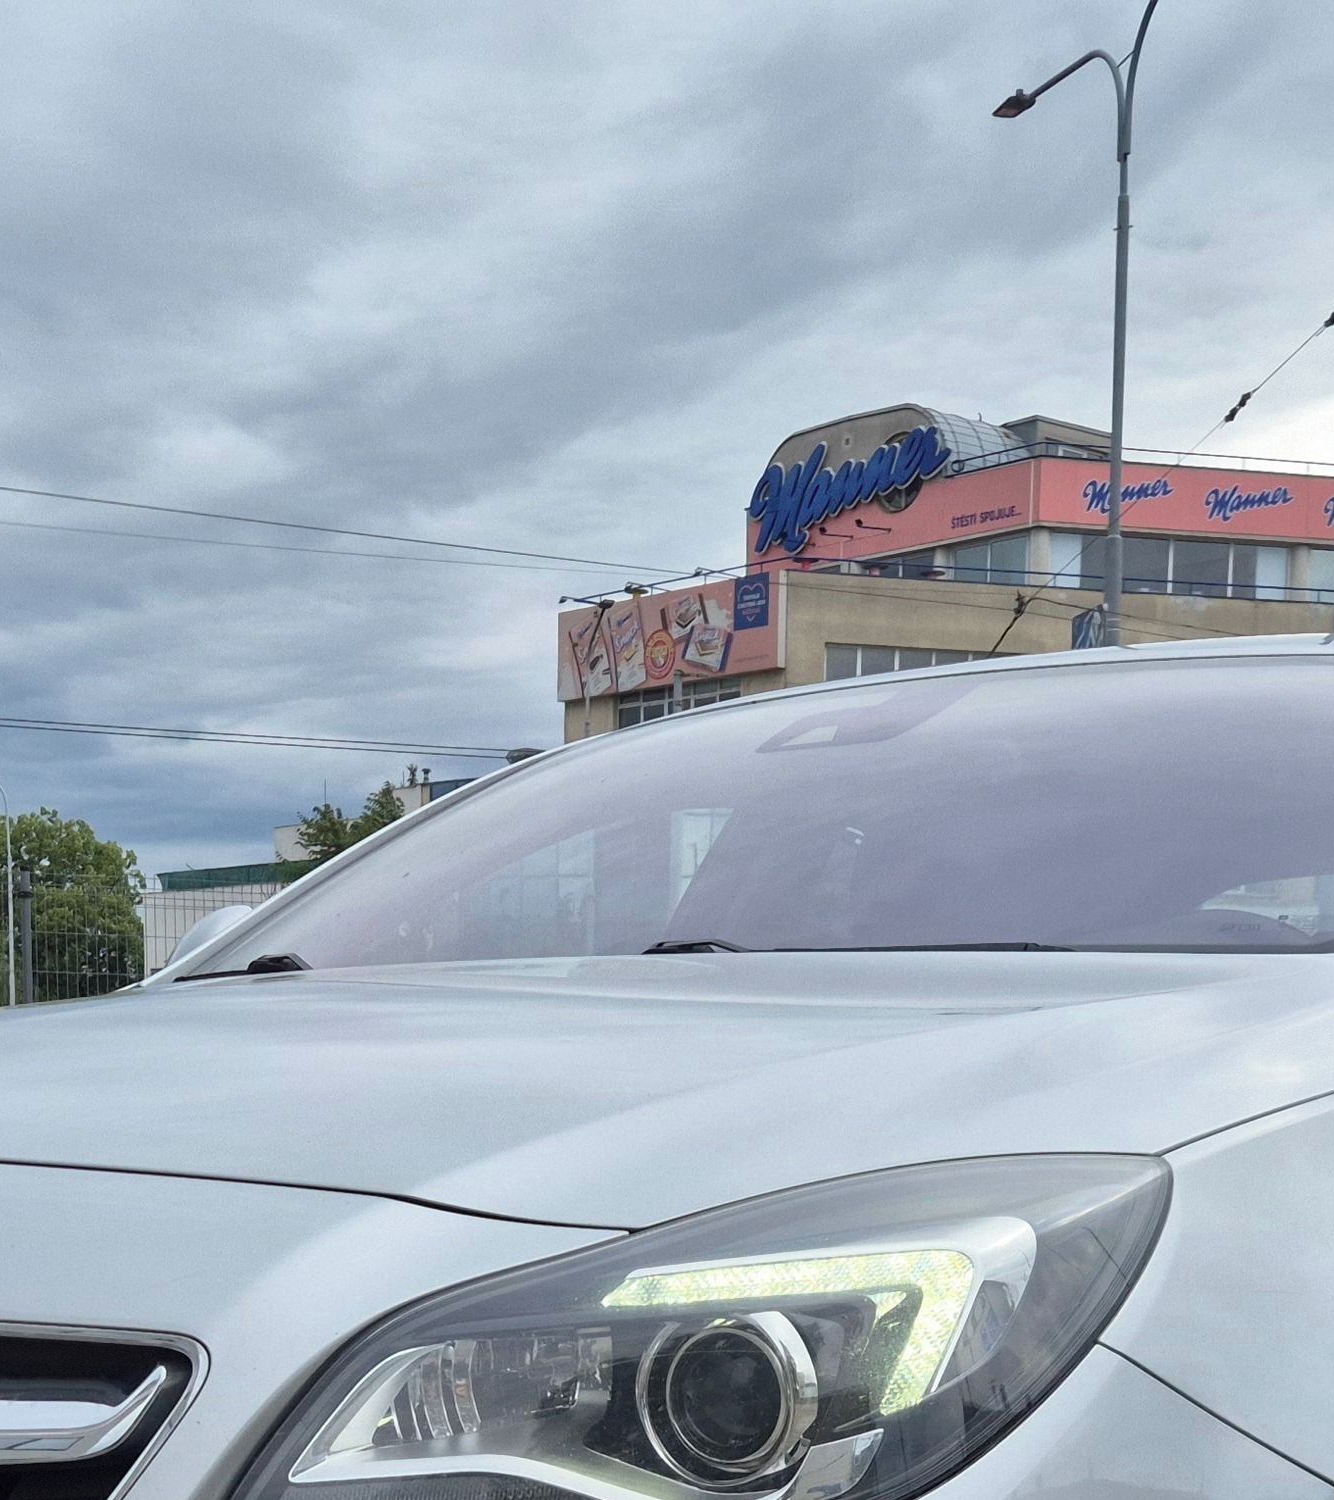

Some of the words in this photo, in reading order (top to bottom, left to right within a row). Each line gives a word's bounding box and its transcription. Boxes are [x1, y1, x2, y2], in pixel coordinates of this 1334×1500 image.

[749, 425, 951, 555] Manner
[1083, 479, 1174, 514] Mnner
[1205, 485, 1294, 521] Manner
